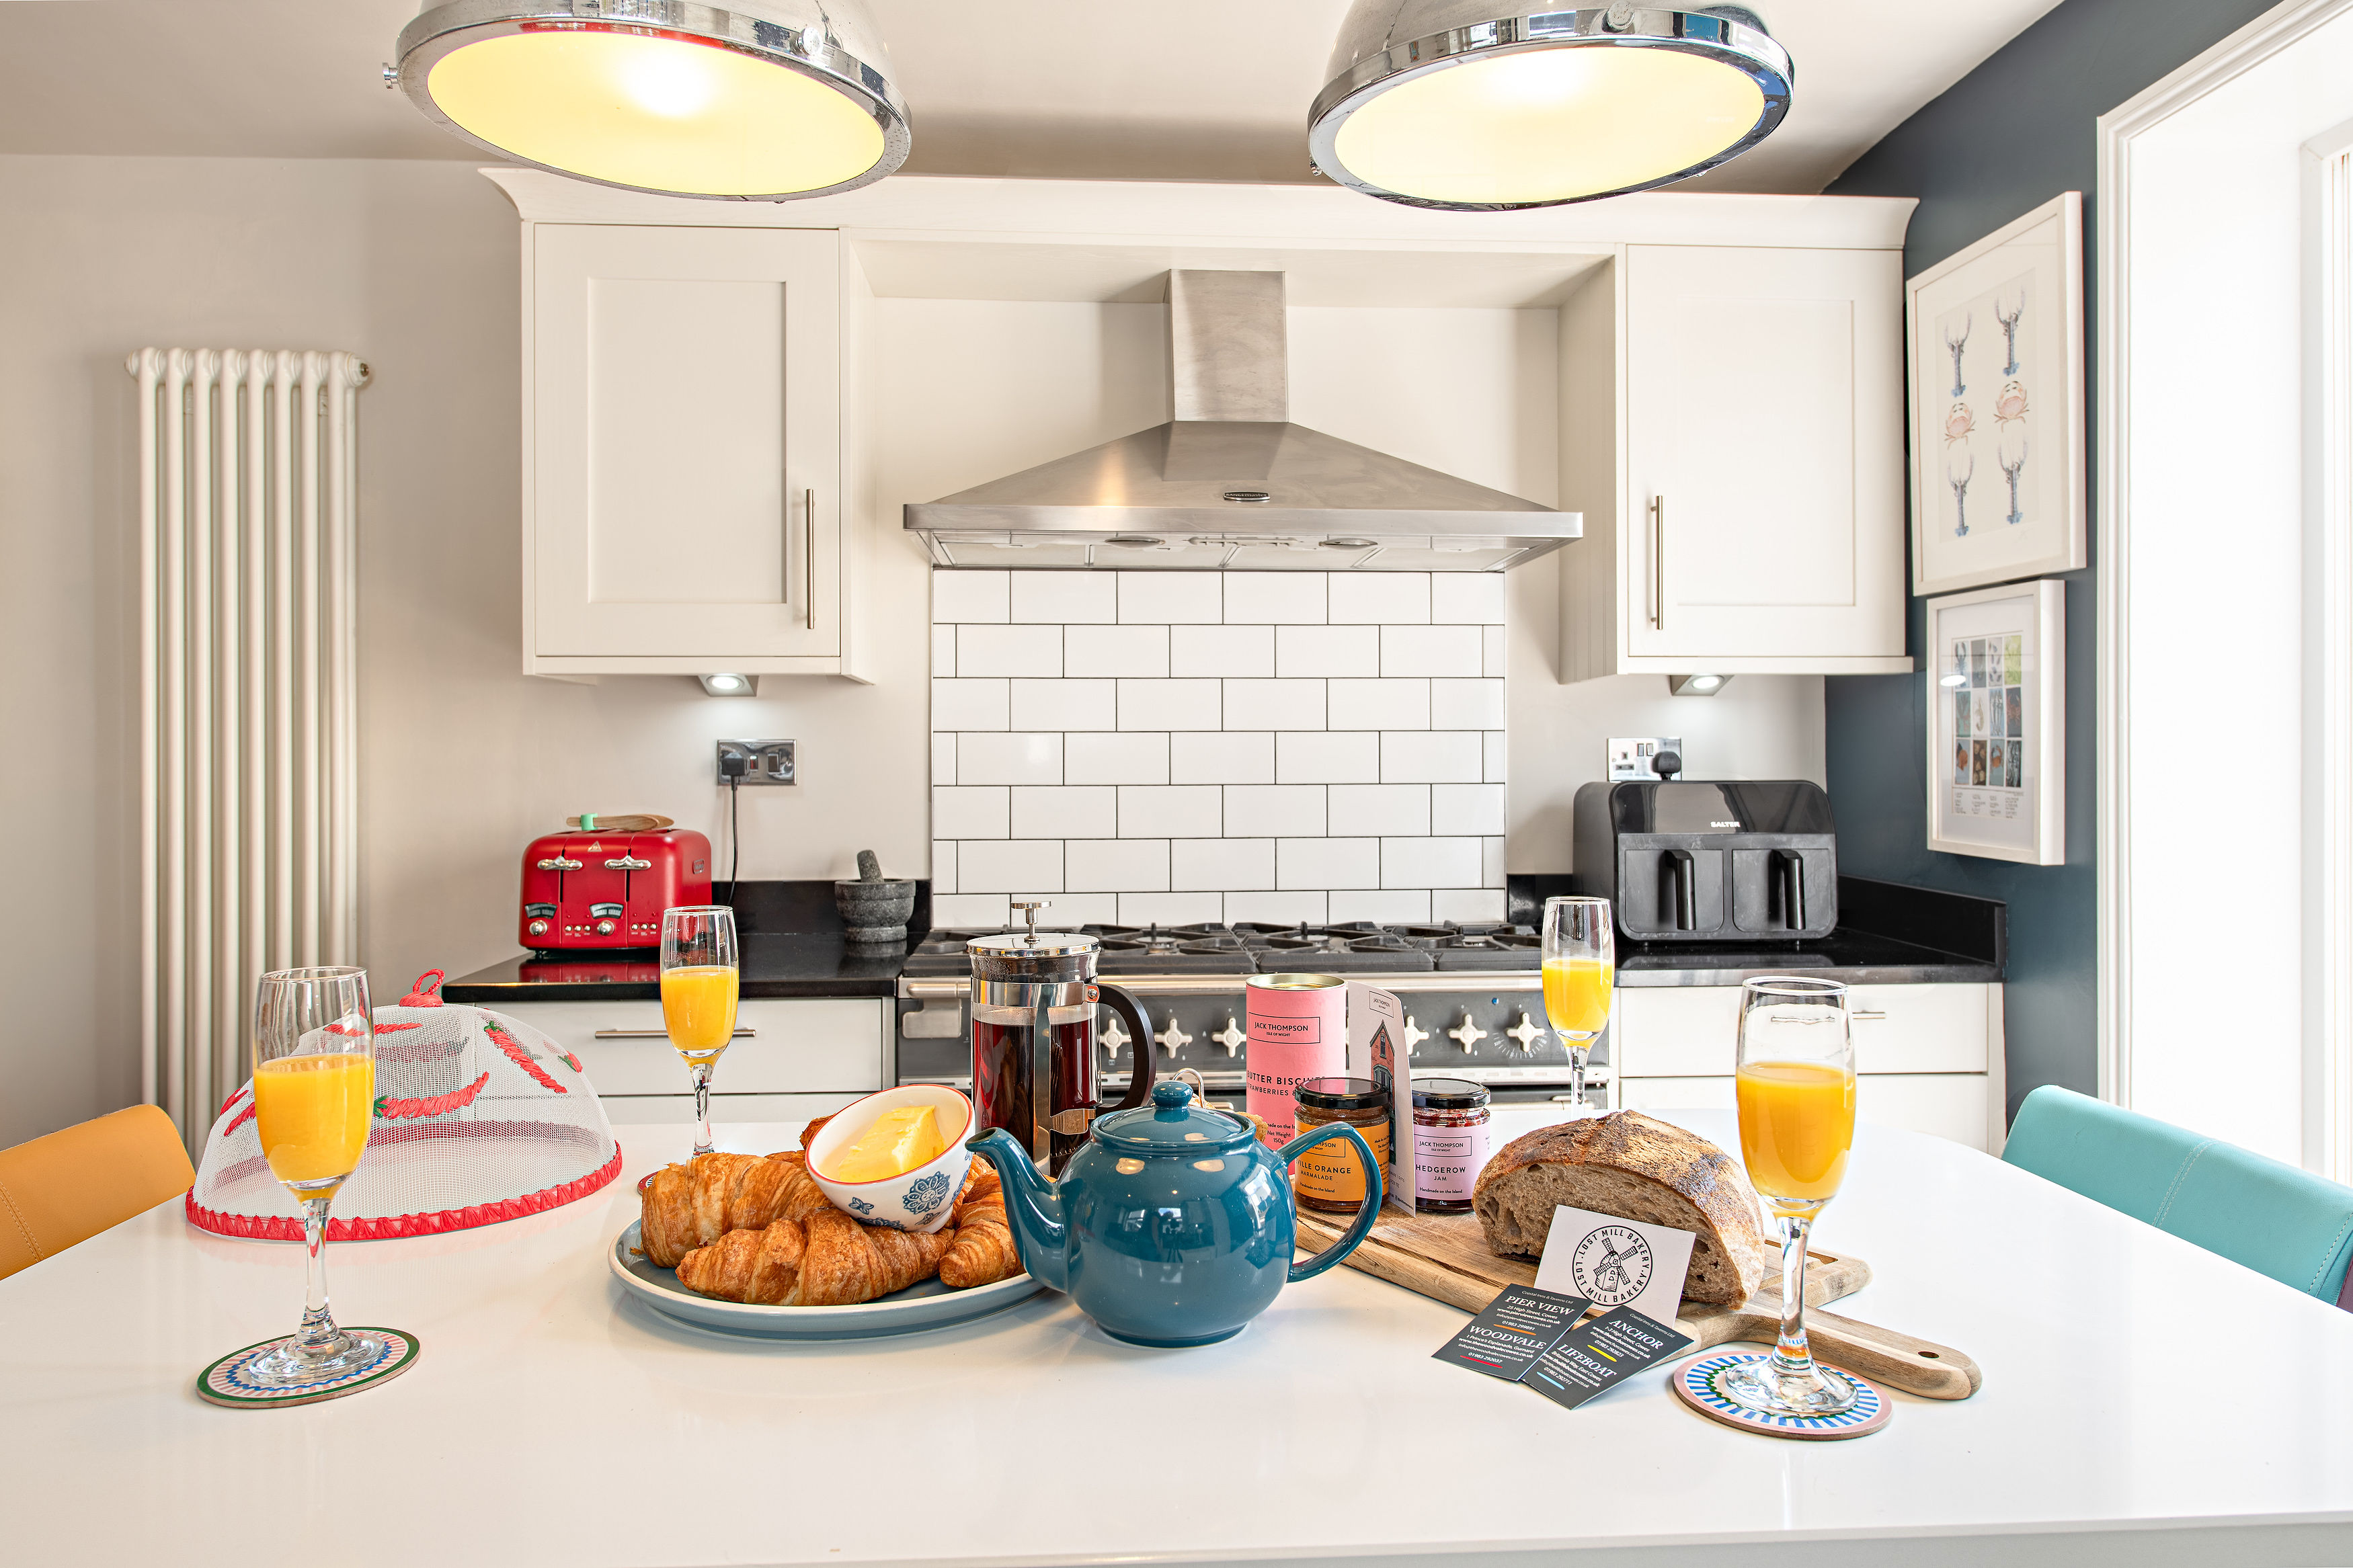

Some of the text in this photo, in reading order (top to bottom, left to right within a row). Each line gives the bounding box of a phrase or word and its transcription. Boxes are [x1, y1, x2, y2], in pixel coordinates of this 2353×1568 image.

[1254, 1022, 1308, 1032] JACK THOMPSON
[1300, 1170, 1333, 1181] MARMALADE
[1314, 1165, 1351, 1174] ORANGE
[1416, 1164, 1466, 1173] HEDGEROW
[1300, 1182, 1314, 1190] Handmade
[1579, 1229, 1649, 1269] LOST MILL BAKERY
[1576, 1262, 1646, 1303] LOST MILL BAKERY
[1505, 1295, 1575, 1315] PIER VIEW
[1497, 1307, 1561, 1325] www.pierviewcowes.co.uk
[1470, 1325, 1547, 1350] WOODVALE
[1609, 1319, 1664, 1350] ANCHOR
[1513, 1346, 1535, 1354] Gurnard
[1634, 1342, 1650, 1352] Cowes
[1557, 1344, 1617, 1378] LIFEBOAT
